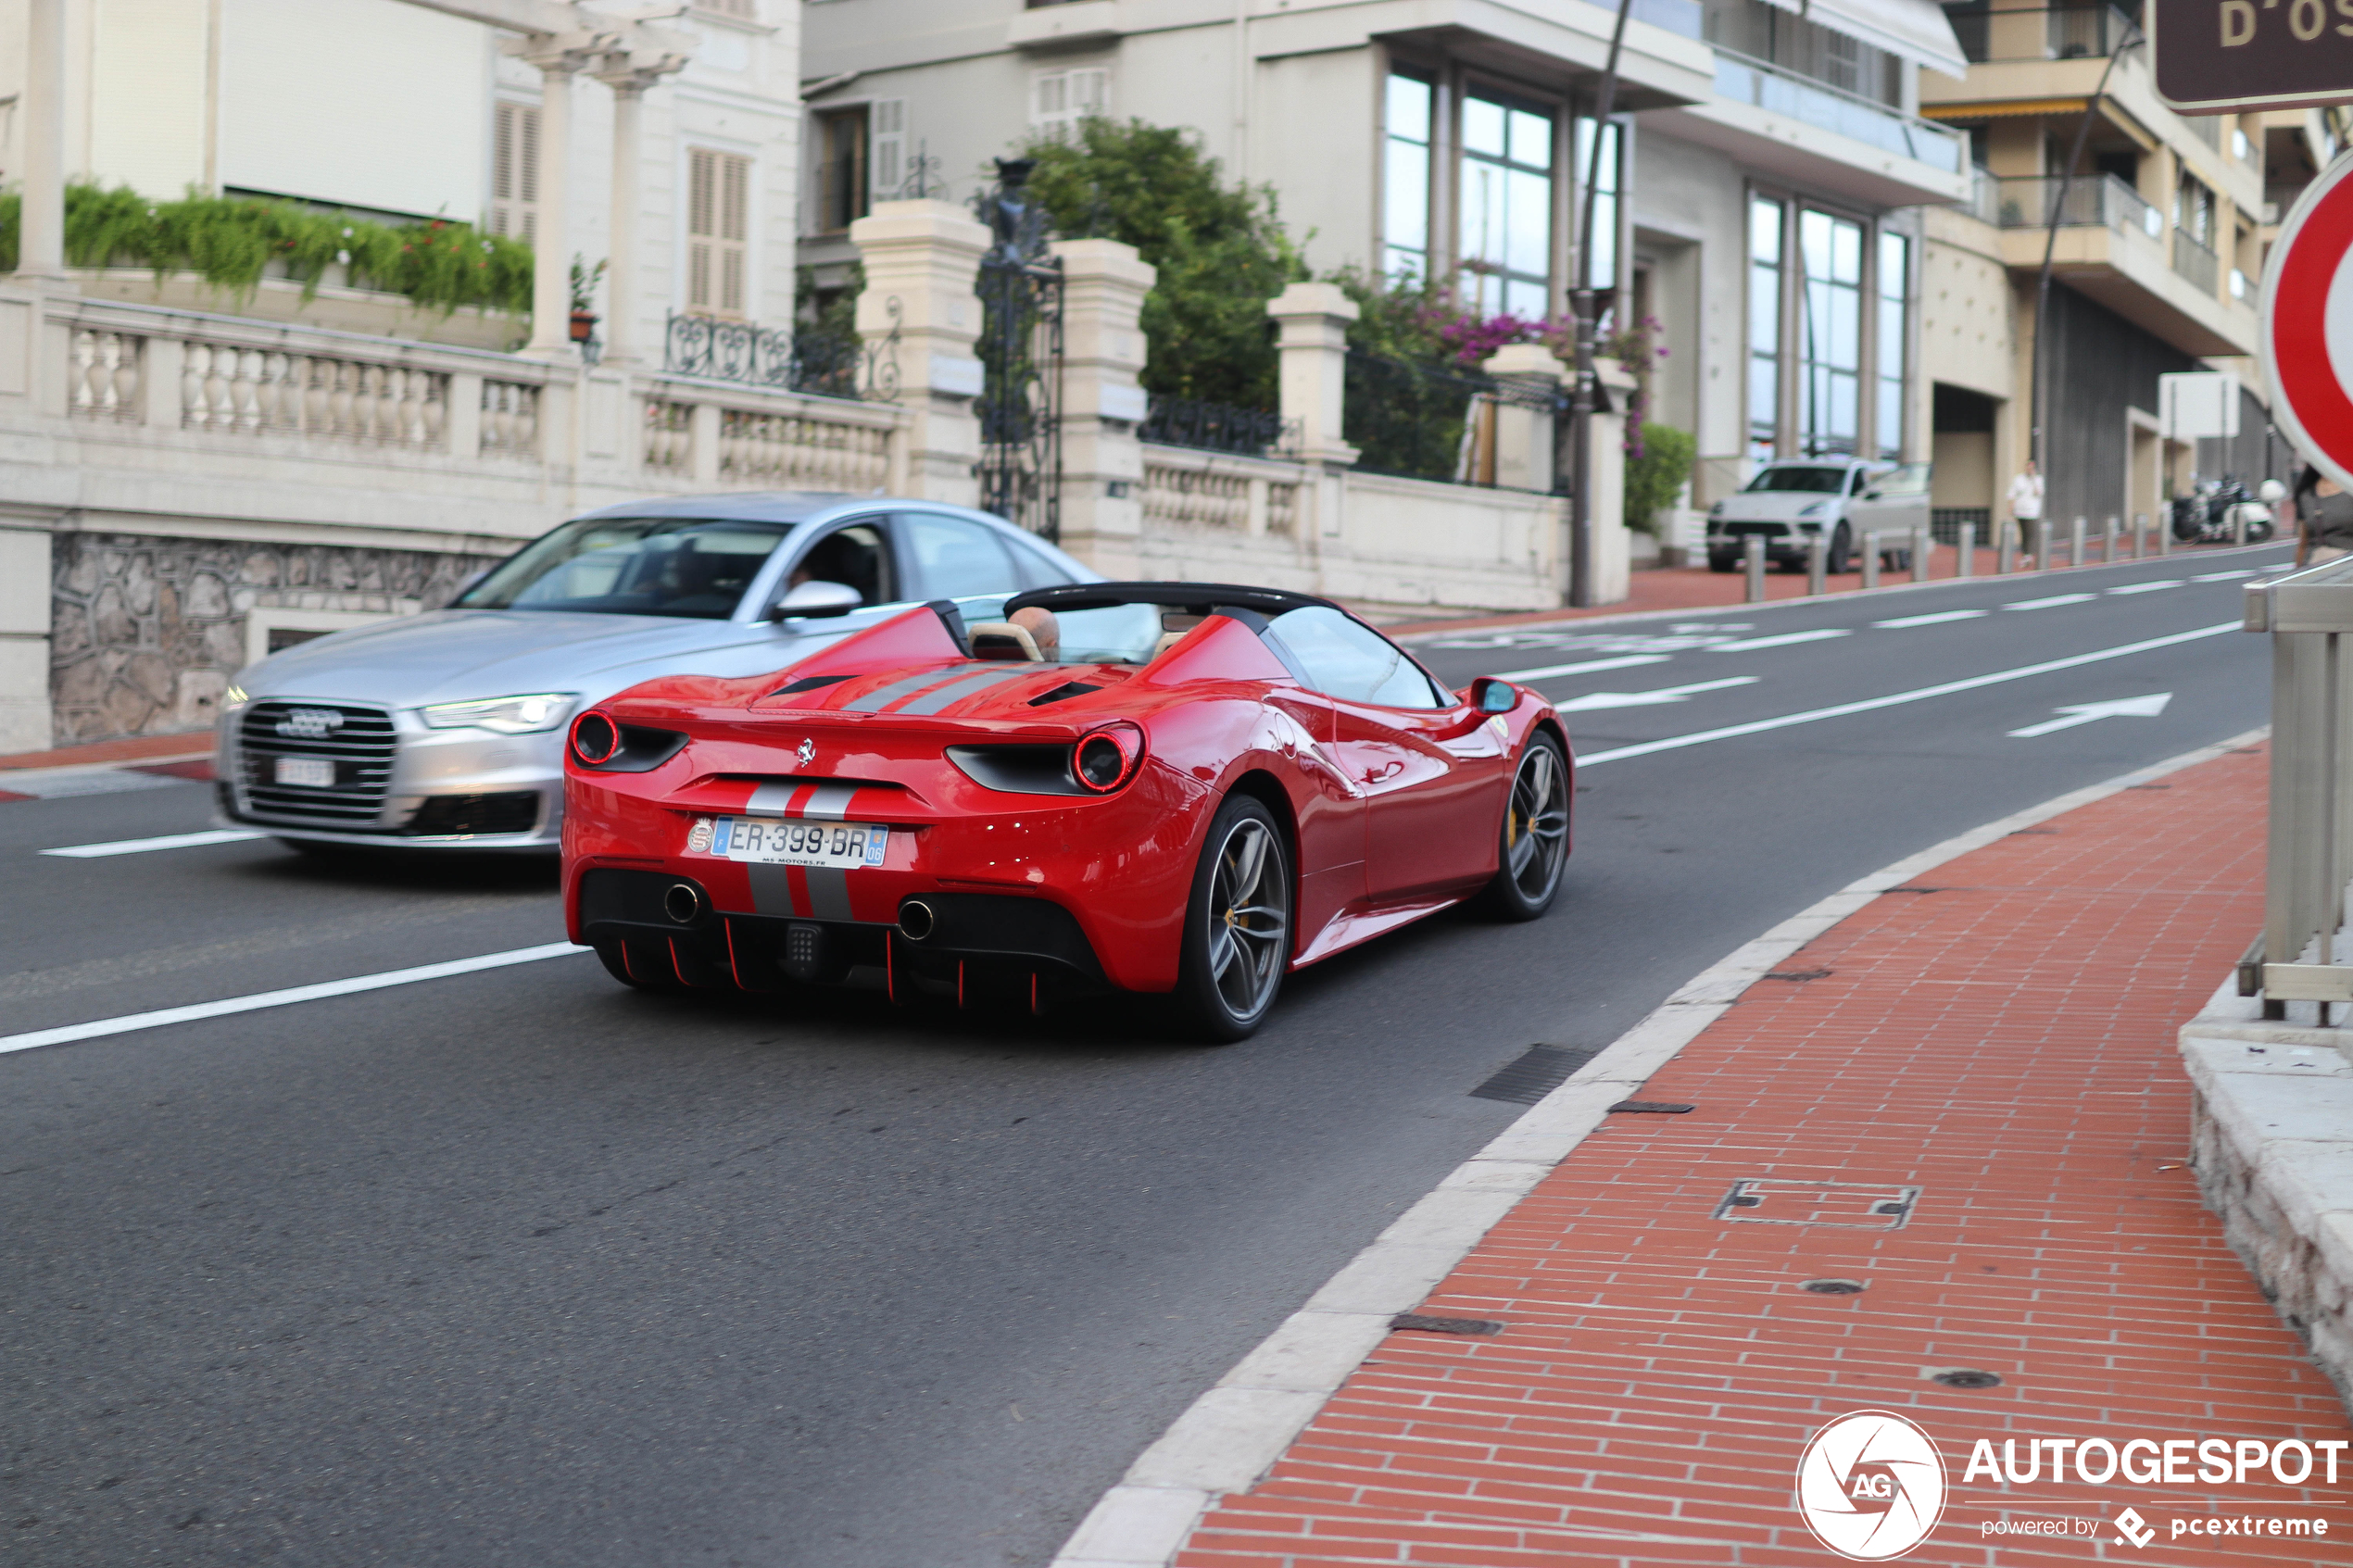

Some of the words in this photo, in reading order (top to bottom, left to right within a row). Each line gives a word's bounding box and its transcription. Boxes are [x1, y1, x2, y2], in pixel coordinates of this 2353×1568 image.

[717, 838, 724, 847] F
[729, 822, 867, 859] ER-399-BR
[866, 847, 882, 861] 06
